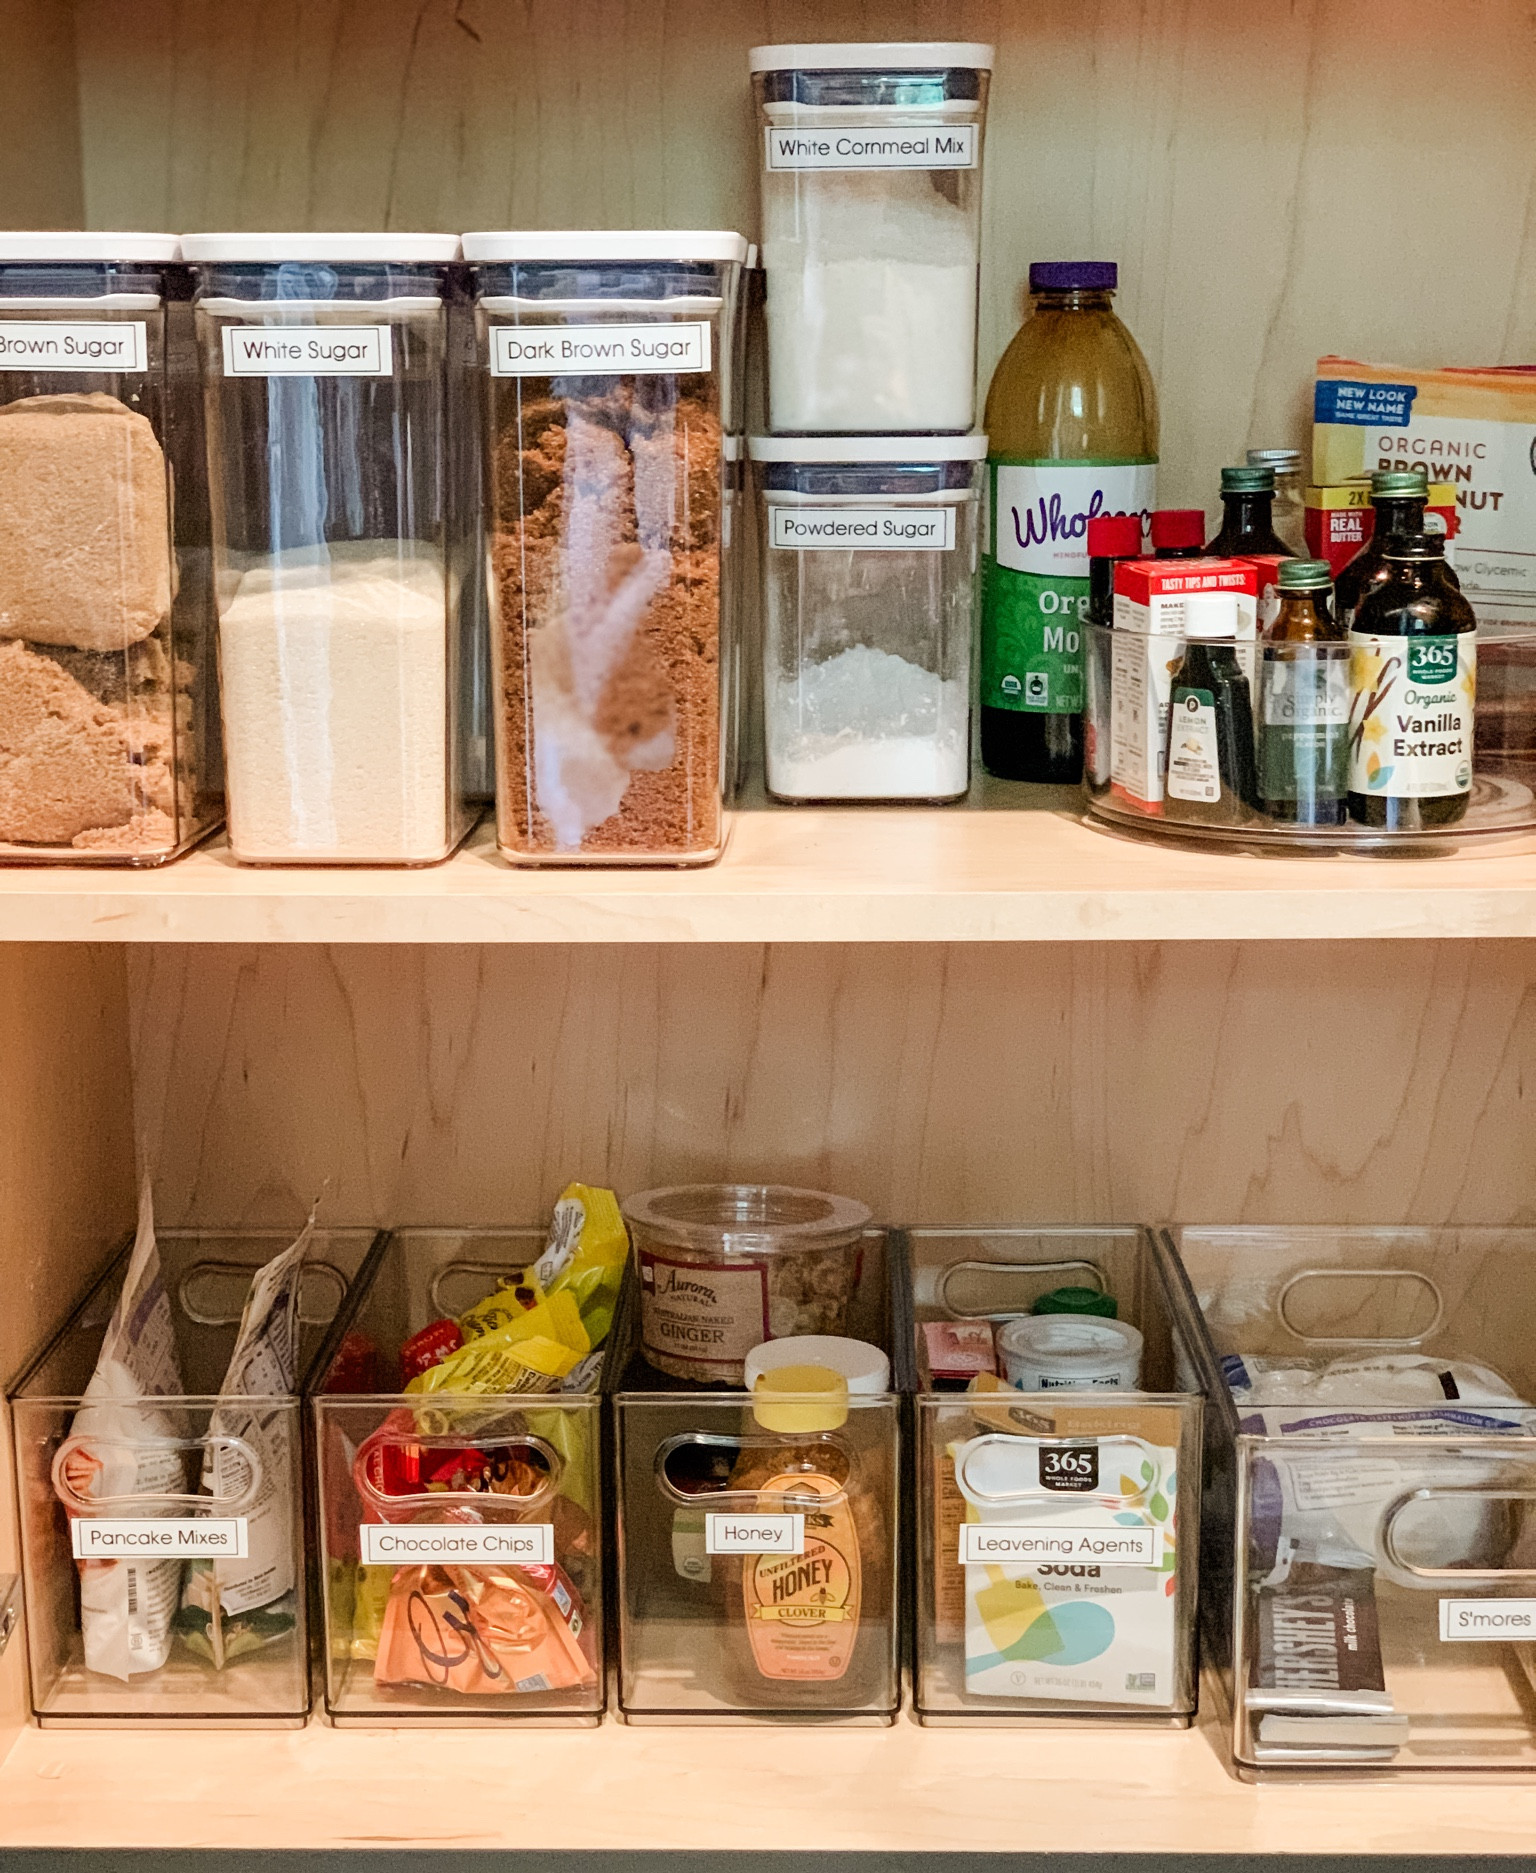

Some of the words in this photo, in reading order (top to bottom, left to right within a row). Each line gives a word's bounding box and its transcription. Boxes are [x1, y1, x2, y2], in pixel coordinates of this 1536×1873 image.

[779, 139, 830, 156] White
[836, 138, 930, 156] Cornmeal
[935, 137, 965, 154] Mix
[64, 337, 124, 357] Sugar
[243, 341, 302, 359] White
[305, 339, 368, 362] Sugar
[508, 340, 555, 359] Dark
[561, 339, 625, 358] Brown
[630, 337, 692, 359] Sugar
[1337, 387, 1366, 398] NEW
[1369, 389, 1406, 401] LOOK
[1336, 399, 1365, 410] NEW
[1367, 402, 1405, 414] NAME
[1378, 436, 1487, 459] ORGANIC
[784, 520, 878, 537] Powdered
[883, 520, 936, 538] Sugar
[1330, 518, 1363, 531] REAL
[1330, 532, 1363, 542] BUTTER
[1161, 578, 1183, 591] TASTY
[1185, 577, 1201, 589] TIPS
[1202, 576, 1217, 588] AND
[1412, 645, 1454, 666] 365
[1404, 690, 1457, 709] Organic
[1178, 715, 1207, 724] LEMON
[1397, 713, 1461, 734] Vanilla
[1394, 738, 1463, 757] Extract
[657, 1269, 717, 1304] Aurora
[660, 1322, 724, 1343] GINGER
[1045, 1451, 1092, 1474] 365
[90, 1530, 173, 1546] Pancake
[178, 1530, 228, 1545] Mixes
[724, 1525, 783, 1543] Honey
[379, 1536, 478, 1551] Chocolate
[483, 1535, 534, 1553] Chips
[977, 1536, 1073, 1556] Leavening
[1079, 1537, 1143, 1558] Agents
[759, 1545, 827, 1578] UNFILTERED
[772, 1558, 833, 1604] HONEY
[1015, 1580, 1041, 1591] Bake,
[1043, 1582, 1072, 1592] Clean
[1074, 1583, 1081, 1592] &
[1084, 1585, 1122, 1595] Freshen
[778, 1607, 826, 1619] CLOVER
[1458, 1610, 1532, 1628] S'mores
[1343, 1634, 1358, 1651] milk
